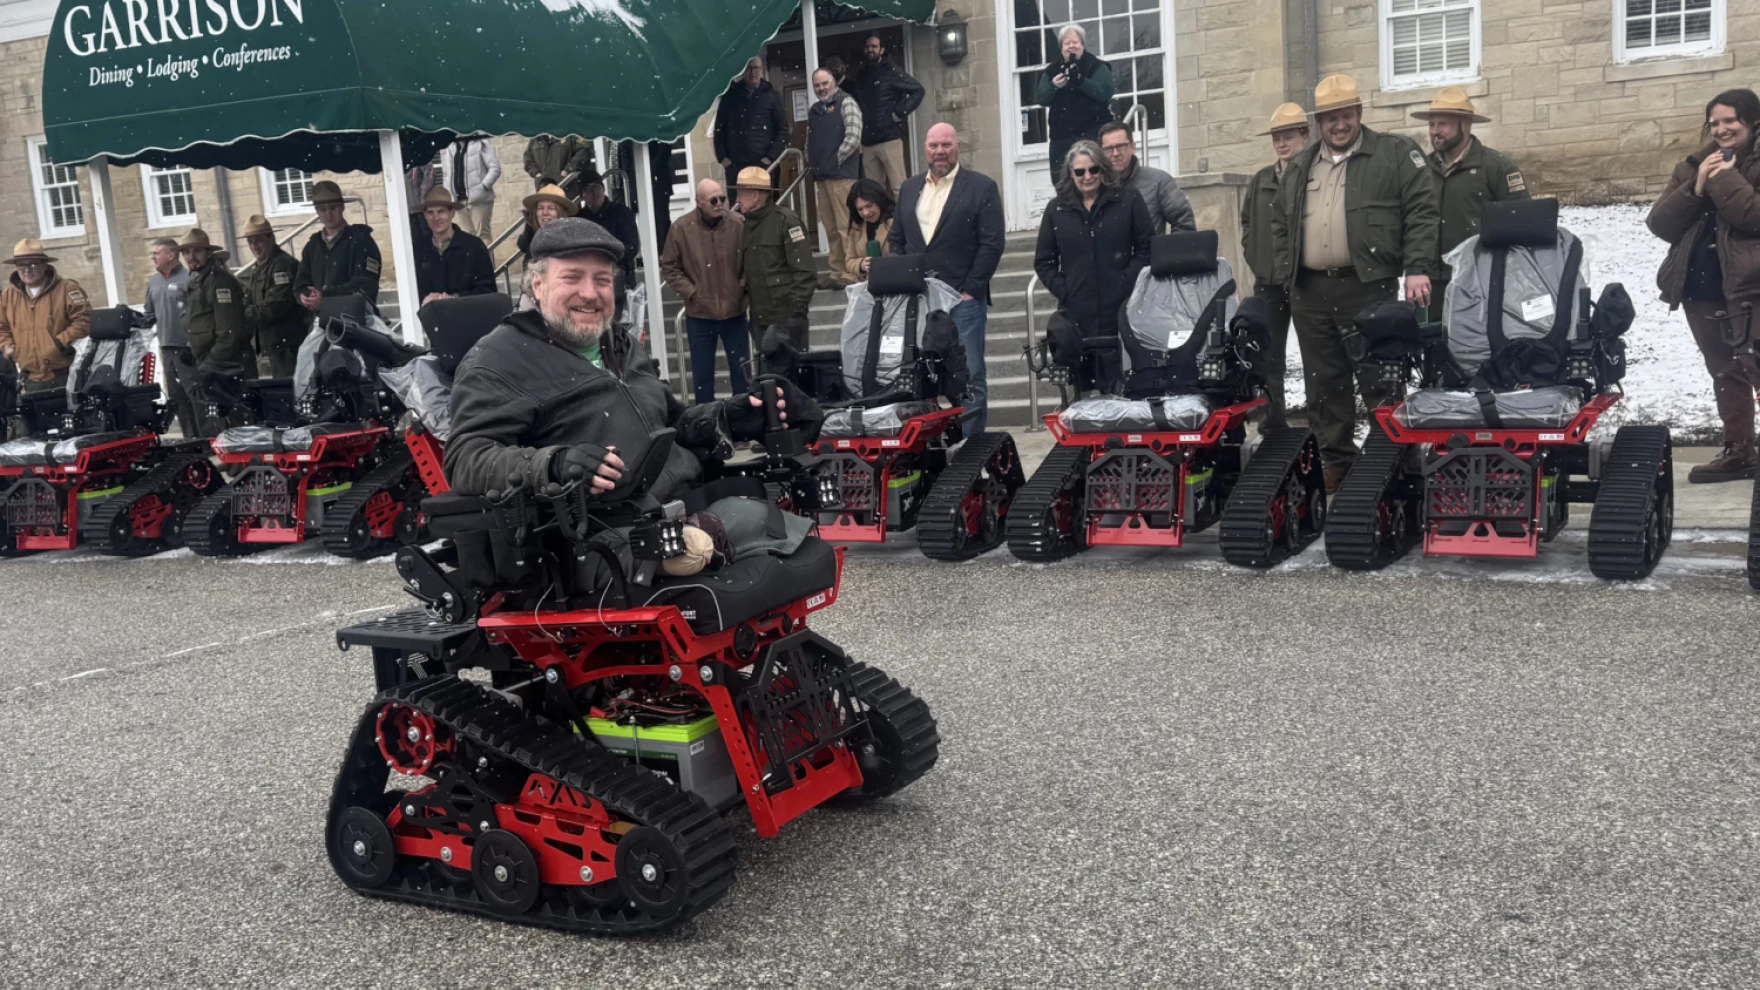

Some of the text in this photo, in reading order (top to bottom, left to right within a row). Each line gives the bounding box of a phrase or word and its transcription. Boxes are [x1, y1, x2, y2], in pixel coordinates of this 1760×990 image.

[64, 0, 303, 56] GARRISON
[89, 43, 291, 87] Dining Lodging Conferences
